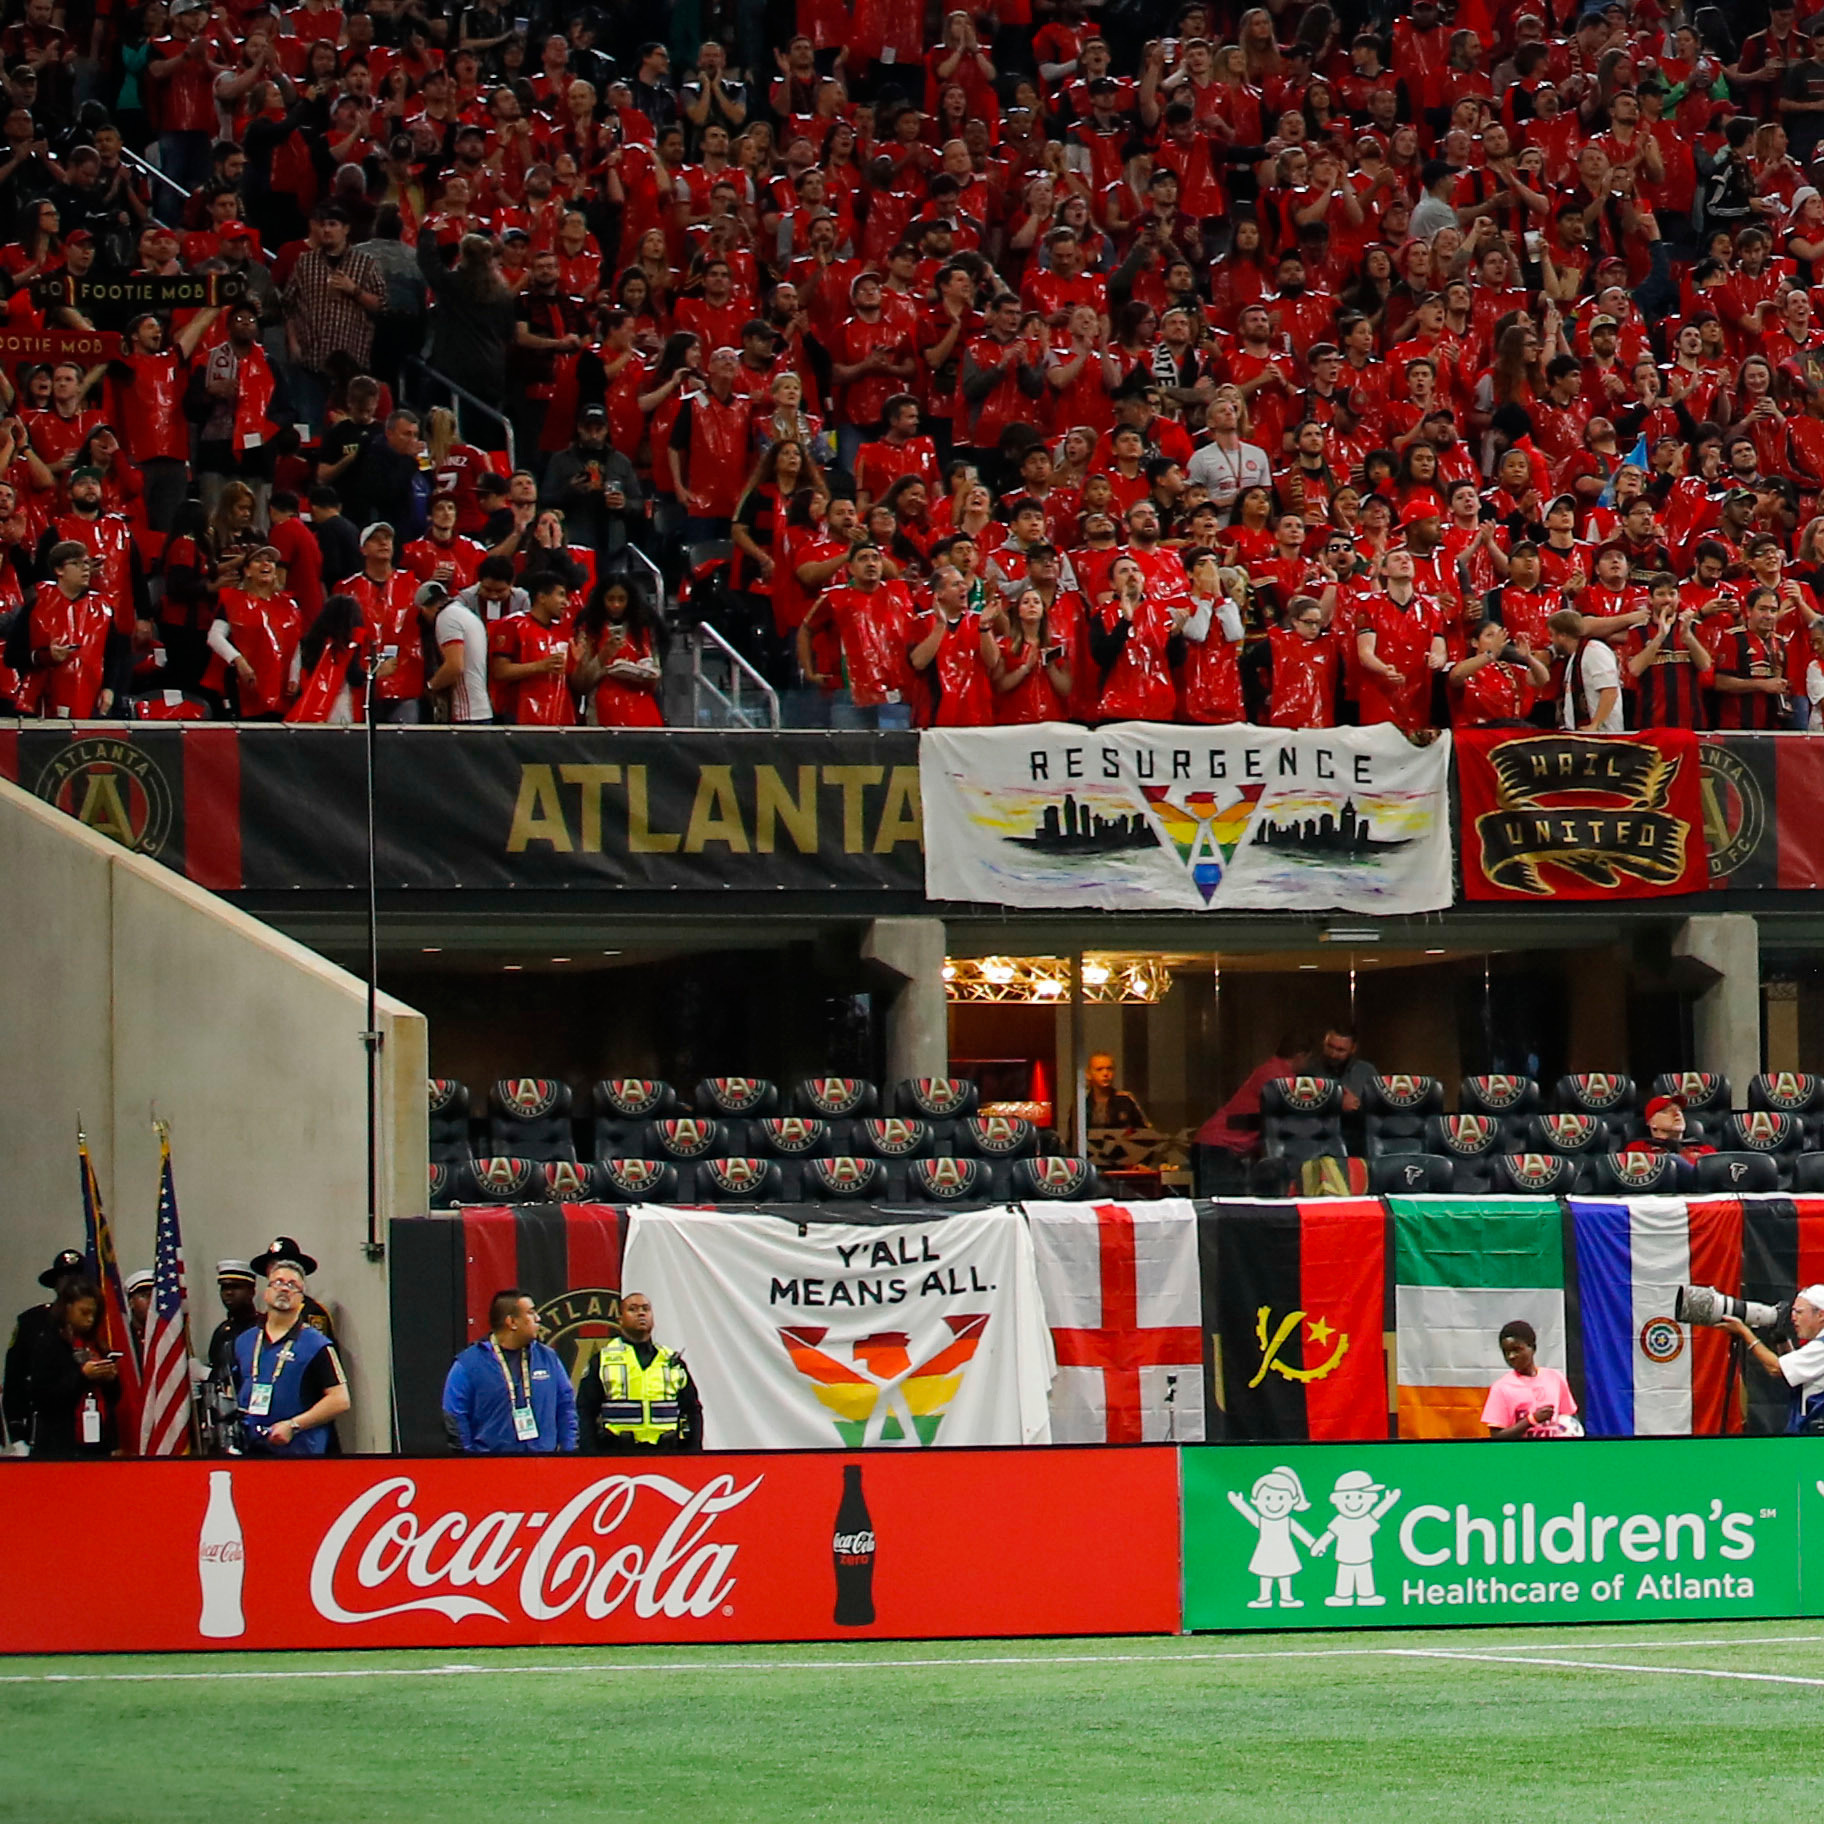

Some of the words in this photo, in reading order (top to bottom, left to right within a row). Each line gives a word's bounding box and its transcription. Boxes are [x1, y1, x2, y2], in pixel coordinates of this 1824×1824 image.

[81, 282, 153, 301] FOOTIE
[160, 284, 207, 301] MOB
[53, 743, 149, 777] ATLANTA
[1030, 747, 1373, 787] RESURGENCE
[1531, 753, 1621, 778] HAIL
[79, 774, 138, 851] A
[506, 763, 928, 853] ATLANTA
[1504, 819, 1658, 848] UNITED
[836, 1234, 940, 1269] Y'ALL
[770, 1276, 907, 1307] MEANS
[920, 1264, 997, 1294] ALL.
[309, 1472, 766, 1625] Coca-Cola
[1398, 1499, 1757, 1567] Children's
[839, 1554, 869, 1566] zero
[1402, 1576, 1580, 1606] Healthcare
[1590, 1573, 1625, 1601] of
[1636, 1572, 1755, 1601] Atlanta
